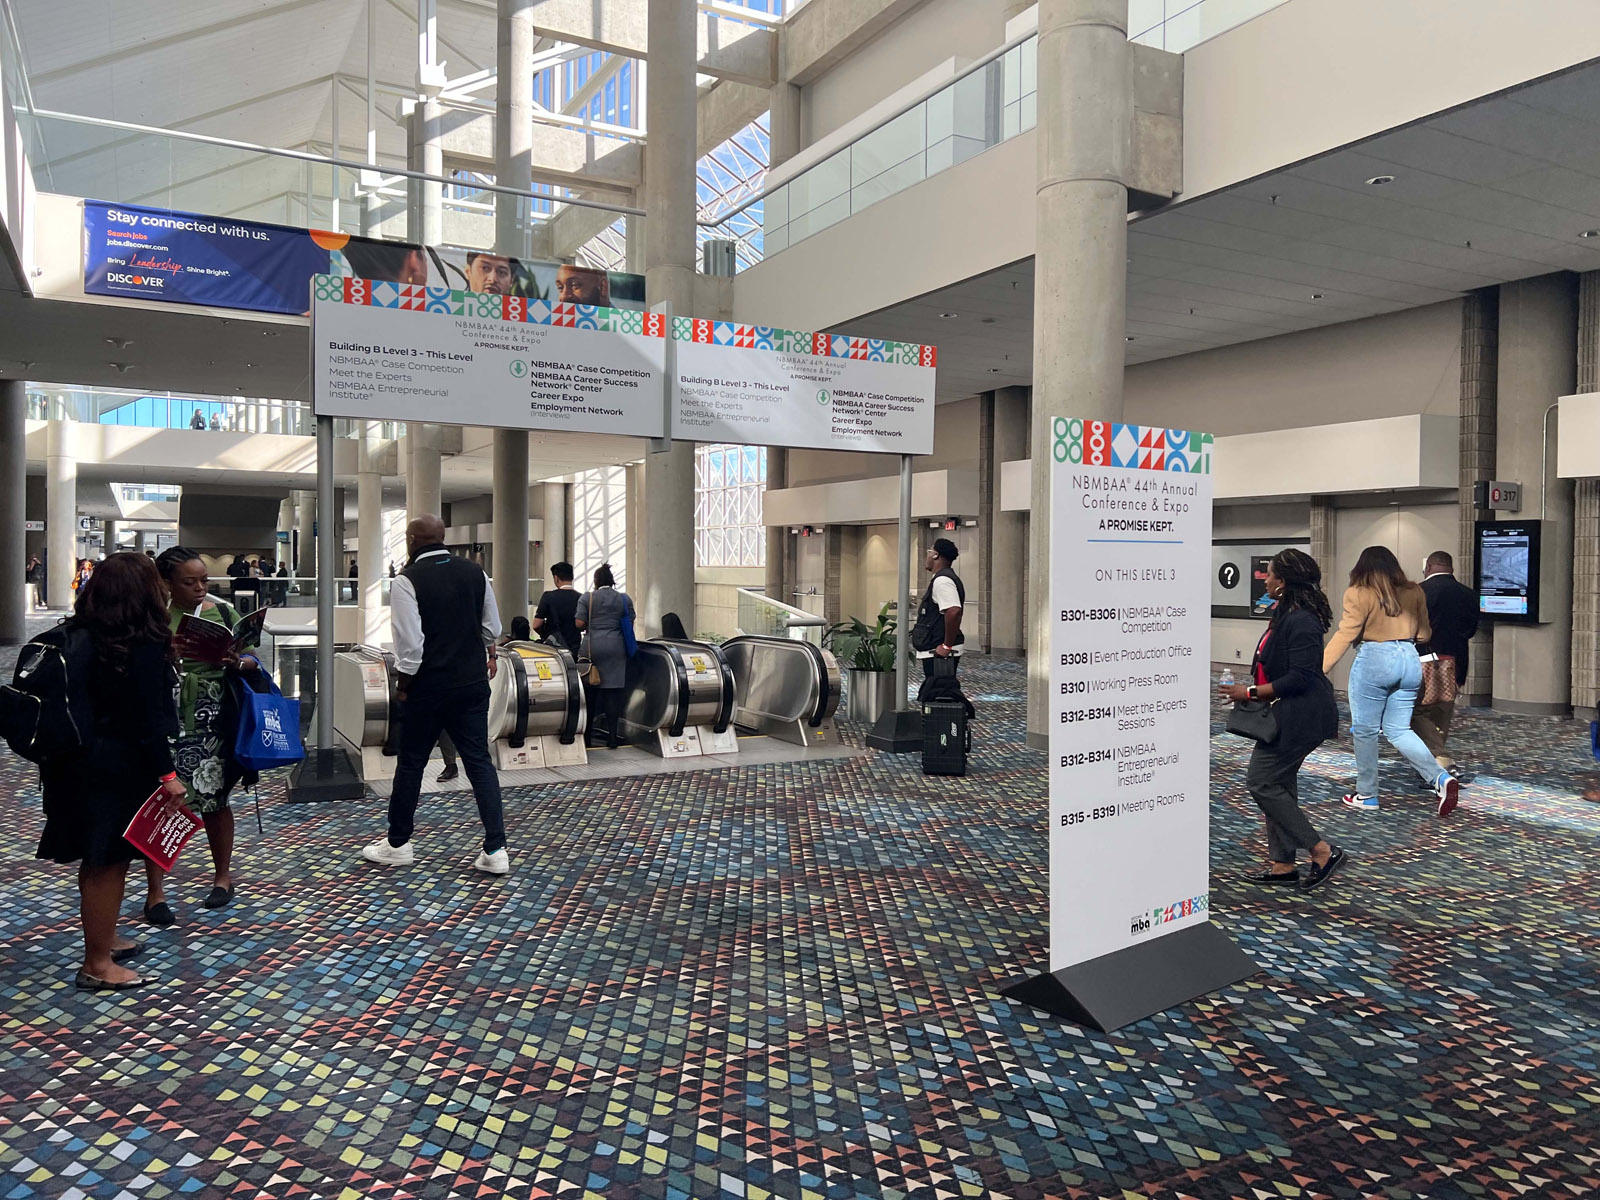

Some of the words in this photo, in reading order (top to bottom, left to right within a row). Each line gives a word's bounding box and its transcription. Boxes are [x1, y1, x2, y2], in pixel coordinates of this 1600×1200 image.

[107, 210, 138, 226] Stay
[141, 214, 216, 234] connected
[220, 226, 249, 238] with
[252, 231, 271, 242] us.
[107, 230, 132, 239] Search
[132, 232, 148, 240] jobs
[106, 239, 168, 252] jobs.discover.com
[107, 258, 126, 266] Bring
[186, 266, 204, 274] Shine
[107, 272, 164, 288] DISCOVER
[462, 330, 510, 341] Conference
[522, 336, 541, 344] Expo
[520, 328, 548, 337] Annual
[330, 342, 371, 354] Building
[374, 346, 381, 354] B
[382, 346, 410, 356] Level
[426, 350, 446, 360] This
[448, 352, 473, 362] Level
[480, 342, 510, 350] PROMISE
[382, 360, 406, 369] Case
[408, 362, 464, 374] Competition
[577, 364, 598, 374] Case
[600, 366, 651, 378] Competition
[781, 364, 818, 374] Conference
[826, 361, 846, 369] Annual
[330, 368, 354, 378] Meet
[356, 370, 373, 379] the
[376, 372, 412, 382] Experts
[531, 371, 572, 382] NBMBAA
[574, 376, 602, 384] Career
[603, 378, 638, 388] Success
[330, 380, 376, 392] NBMBAA
[378, 384, 448, 398] Entrepreneurial
[574, 384, 602, 392] Center
[680, 376, 712, 386] Building
[714, 378, 720, 386] B
[721, 378, 741, 388] Level
[754, 382, 770, 390] This
[770, 384, 790, 392] Level
[531, 391, 560, 400] Career
[562, 394, 584, 403] Expo
[720, 390, 739, 400] Case
[740, 392, 783, 404] Competition
[868, 392, 884, 400] Case
[884, 394, 925, 404] Competition
[531, 402, 587, 414] Employment
[588, 406, 624, 416] Network
[680, 398, 700, 407] Meet
[701, 400, 714, 408] the
[715, 401, 743, 411] Experts
[832, 399, 864, 408] NBMBAA
[864, 402, 886, 410] Career
[888, 404, 915, 412] Success
[680, 410, 716, 420] NBMBAA
[716, 412, 770, 424] Entrepreneurial
[864, 410, 887, 418] Center
[832, 416, 854, 424] Career
[856, 419, 872, 427] Expo
[832, 426, 874, 436] Employment
[1134, 478, 1158, 492] 44th
[1162, 482, 1198, 496] Annual
[1503, 490, 1517, 502] 317
[1082, 494, 1147, 511] Conference
[1151, 498, 1159, 512] &
[1164, 498, 1189, 516] Expo
[1099, 519, 1106, 530] A
[1108, 520, 1148, 532] PROMISE
[1150, 521, 1174, 532] KEPT.
[1096, 569, 1112, 582] ON
[1116, 569, 1138, 581] THIS
[1142, 569, 1167, 581] LEVEL
[1170, 568, 1176, 581] 3
[1061, 608, 1116, 621] B301-B306
[1166, 606, 1186, 618] Case
[1122, 620, 1172, 635] Competition
[1061, 652, 1088, 665] B308
[1094, 651, 1119, 663] Event
[1121, 648, 1166, 661] Production
[1168, 645, 1192, 658] Office
[1061, 682, 1086, 694] B310
[1092, 678, 1126, 692] Working
[1128, 676, 1152, 688] Press
[1154, 673, 1178, 685] Room
[1061, 706, 1112, 724] B312-B314
[1118, 704, 1139, 716] Meet
[1140, 702, 1155, 714] the
[1156, 699, 1188, 714] Experts
[1118, 716, 1156, 730] Sessions
[1061, 749, 1112, 767] B312-B314
[1118, 743, 1156, 758] NBMBAA
[1118, 752, 1180, 772] Entrepreneurial
[1061, 812, 1084, 826] B315
[1092, 806, 1116, 820] B319
[1122, 799, 1155, 814] Meeting
[1156, 792, 1185, 806] Rooms
[178, 818, 191, 830] Big
[167, 845, 178, 858] The
[1131, 919, 1150, 933] mba
